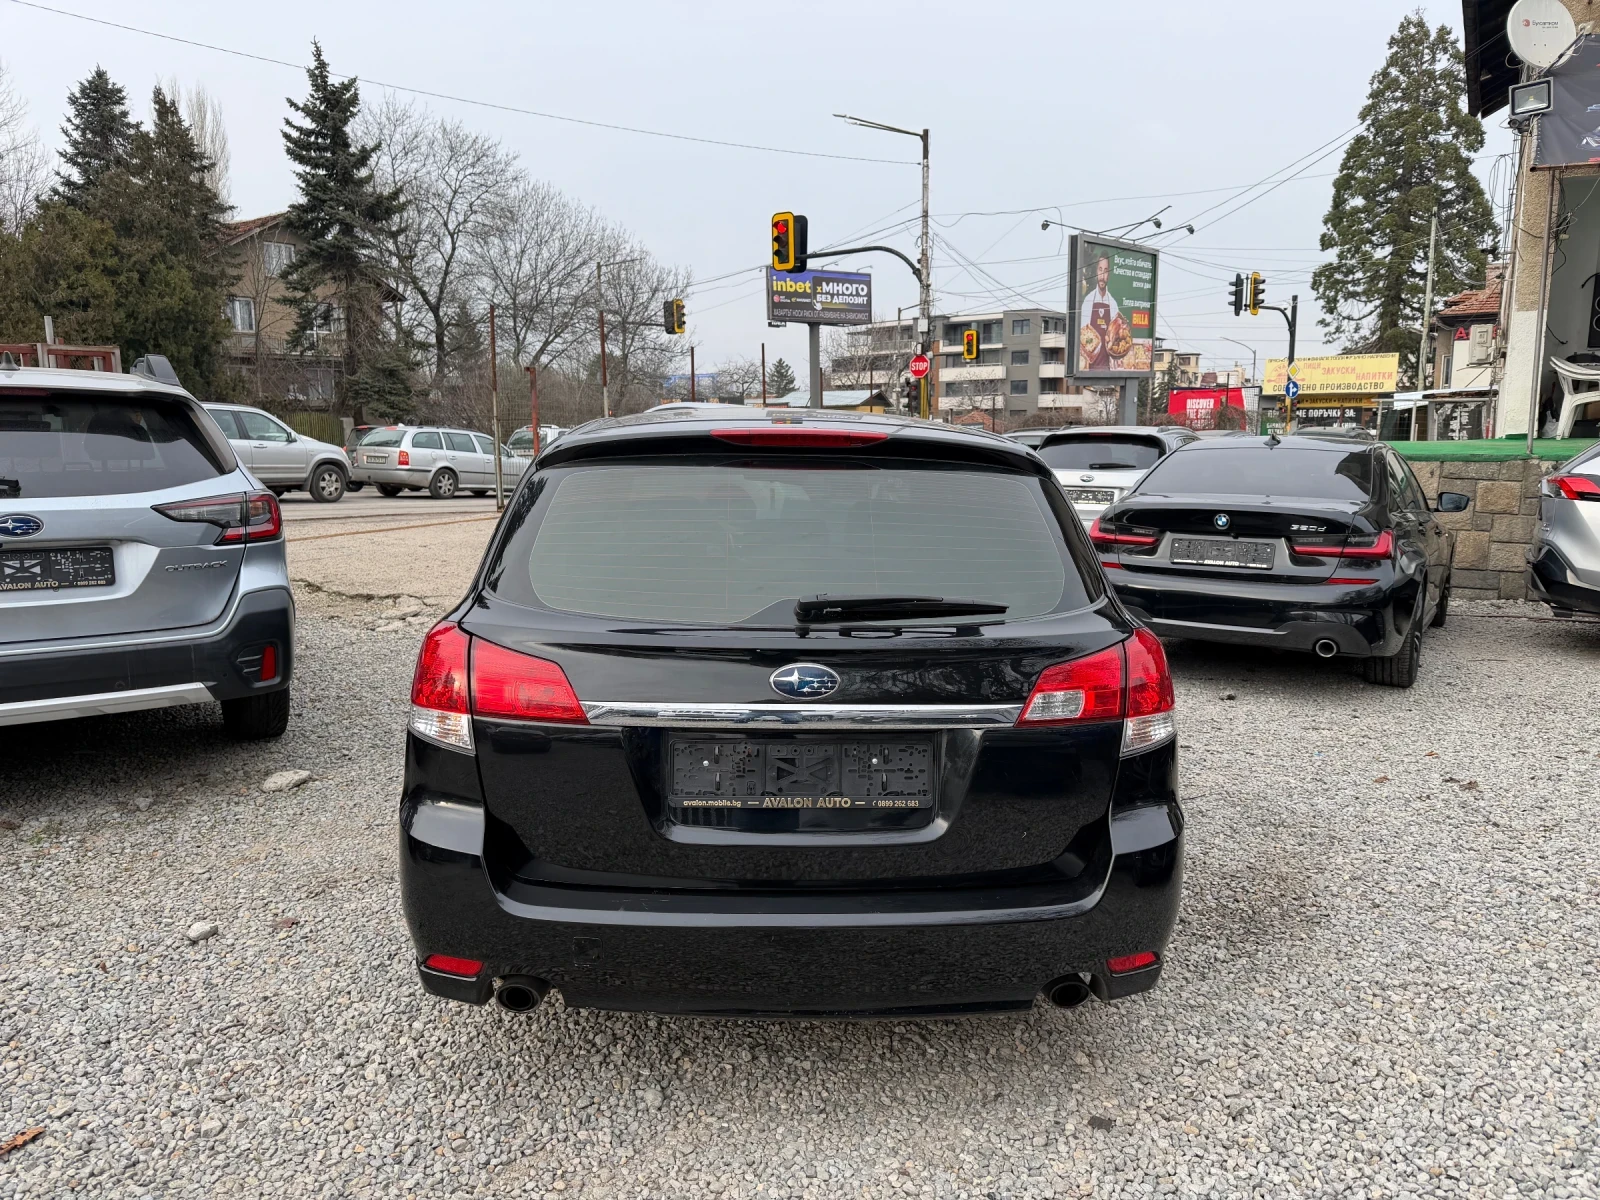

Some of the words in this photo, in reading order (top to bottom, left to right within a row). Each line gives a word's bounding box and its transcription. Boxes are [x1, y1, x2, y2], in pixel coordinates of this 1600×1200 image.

[773, 276, 811, 293] inbet
[816, 294, 832, 303] БЕЗ
[832, 296, 868, 305] ДЕПОЗИТ
[1133, 314, 1149, 324] BILLA
[911, 361, 928, 371] STOP
[1321, 366, 1356, 376] ЗАКУСКИ
[1355, 371, 1393, 381] НАПИТКИ
[1320, 381, 1385, 391] ПРОИЗВОДСТВО
[1187, 399, 1214, 408] DISCOVER
[165, 560, 227, 571] OUTBACK
[683, 799, 742, 807] avalon.mobile.bg
[762, 797, 812, 808] AVALON
[816, 797, 851, 808] AUTO
